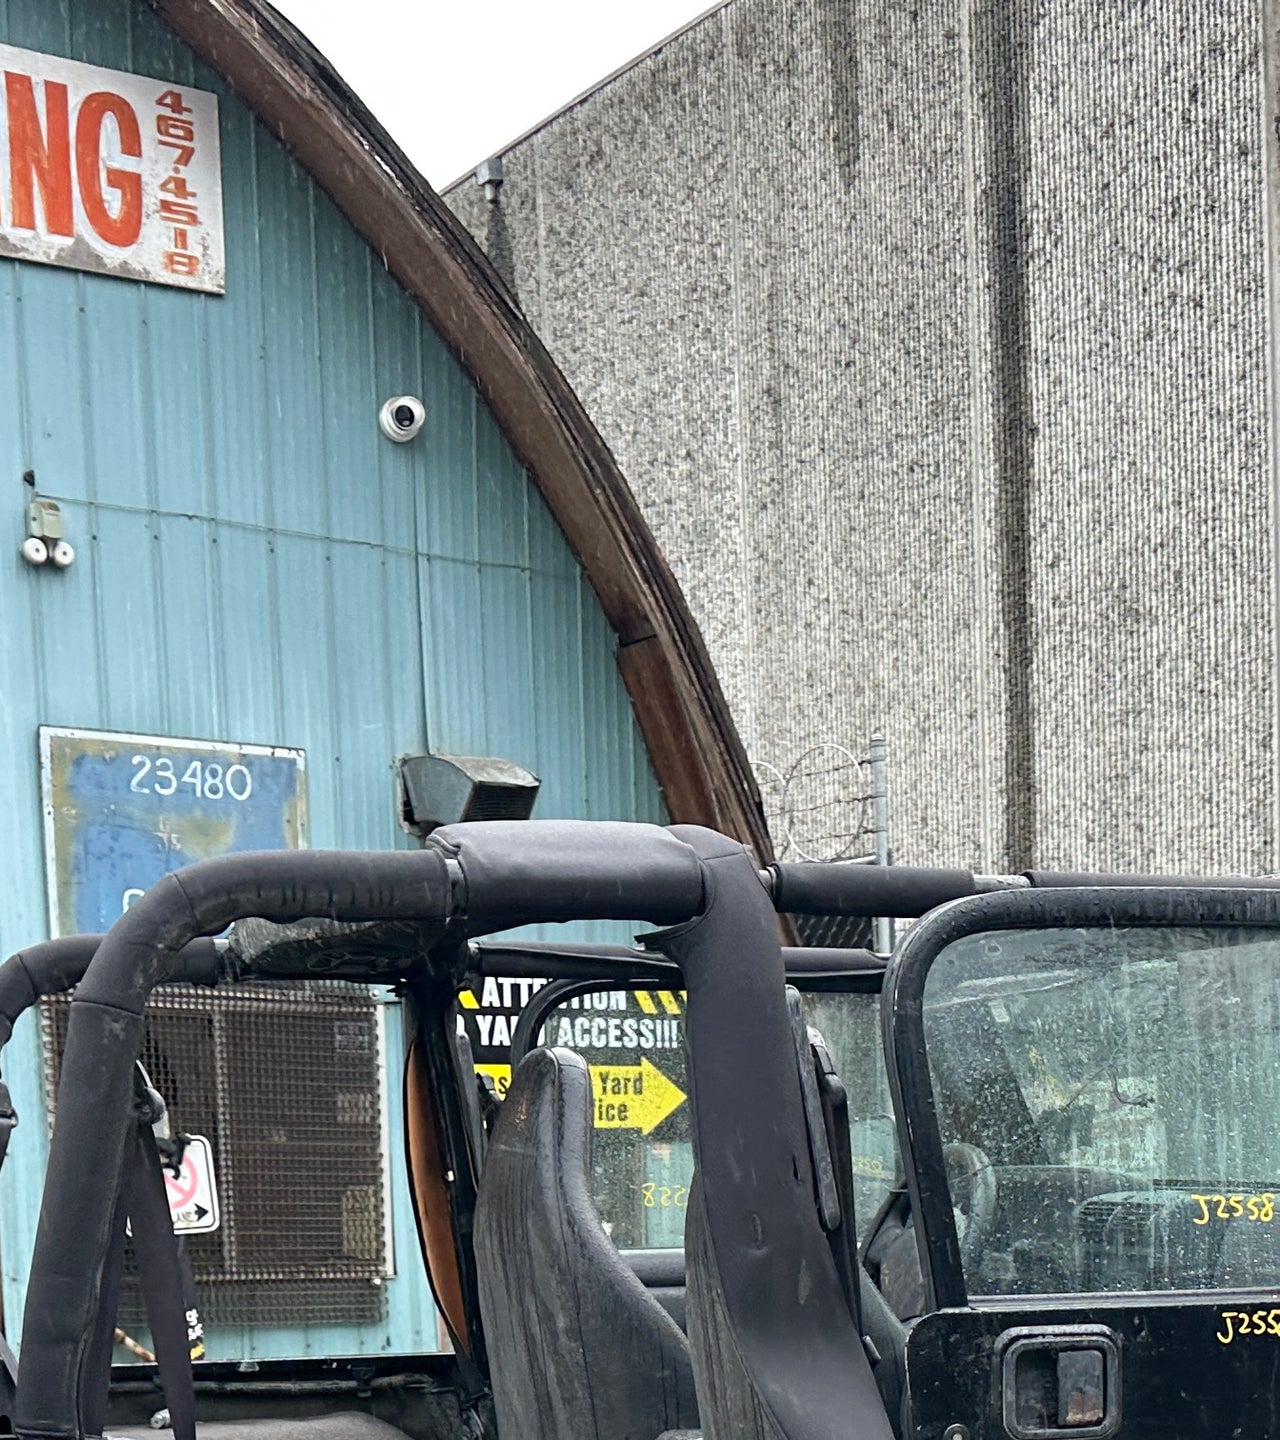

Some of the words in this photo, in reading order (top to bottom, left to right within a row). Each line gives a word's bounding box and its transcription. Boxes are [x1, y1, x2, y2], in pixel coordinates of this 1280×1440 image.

[129, 754, 253, 801] 23480
[557, 1016, 679, 1049] ACCESS!!!
[598, 1070, 644, 1097] Yard
[1191, 1192, 1276, 1225] J2558
